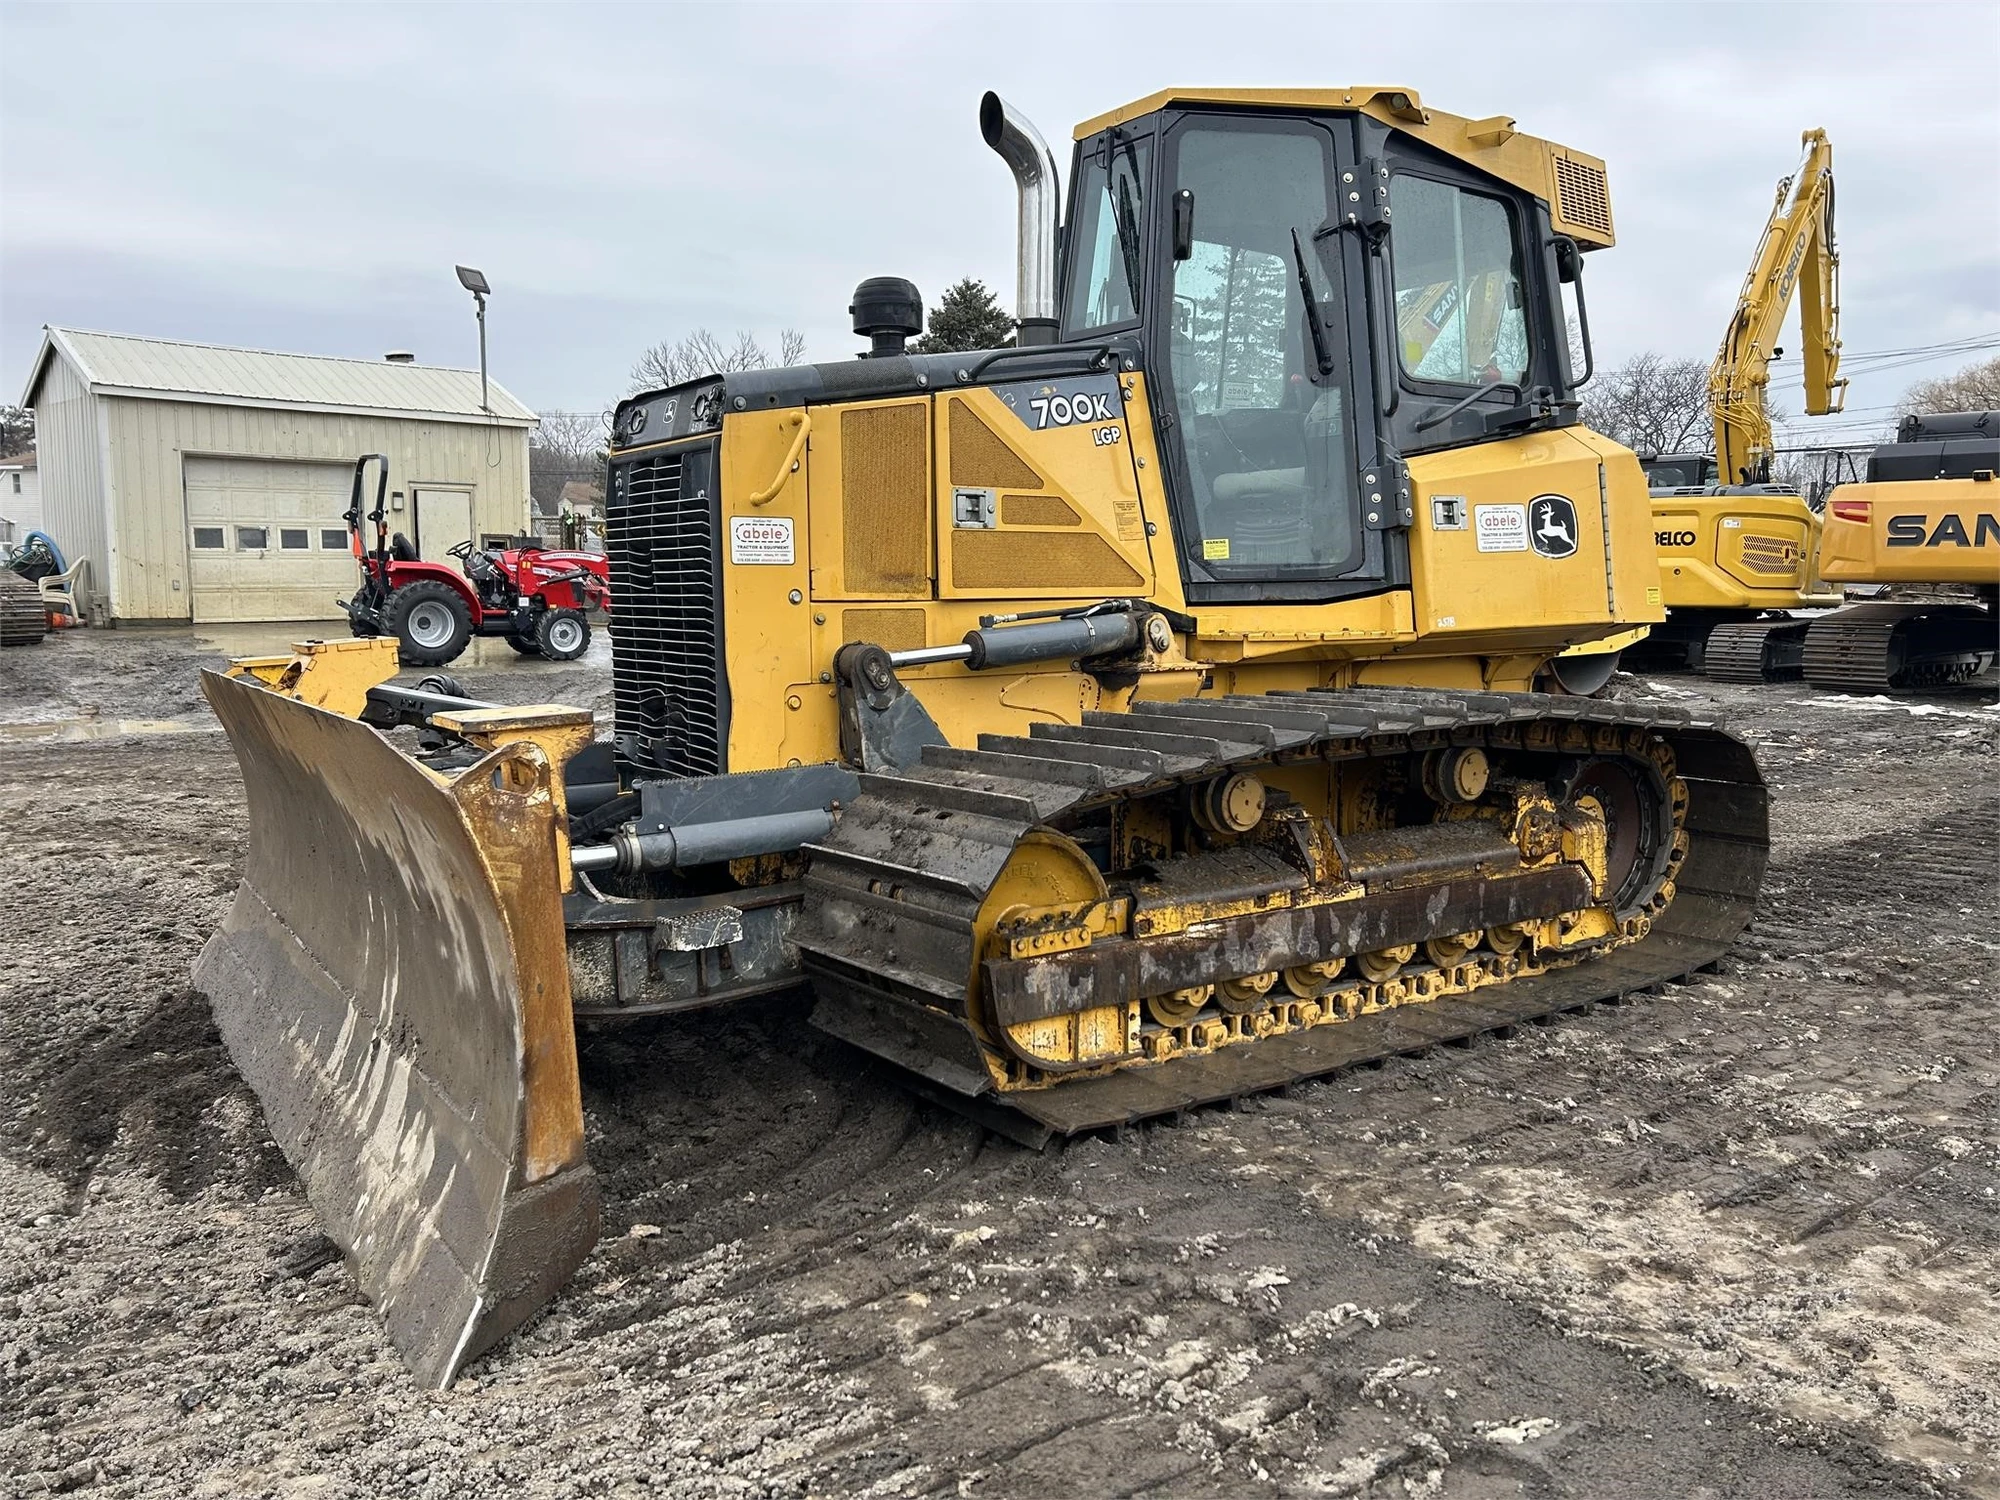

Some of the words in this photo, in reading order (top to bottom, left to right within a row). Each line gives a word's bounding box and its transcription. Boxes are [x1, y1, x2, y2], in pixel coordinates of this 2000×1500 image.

[1779, 231, 1806, 302] KOBELCO
[1029, 392, 1116, 430] 700K
[1092, 426, 1121, 446] LGP
[1485, 515, 1517, 527] abele
[742, 527, 783, 540] abele
